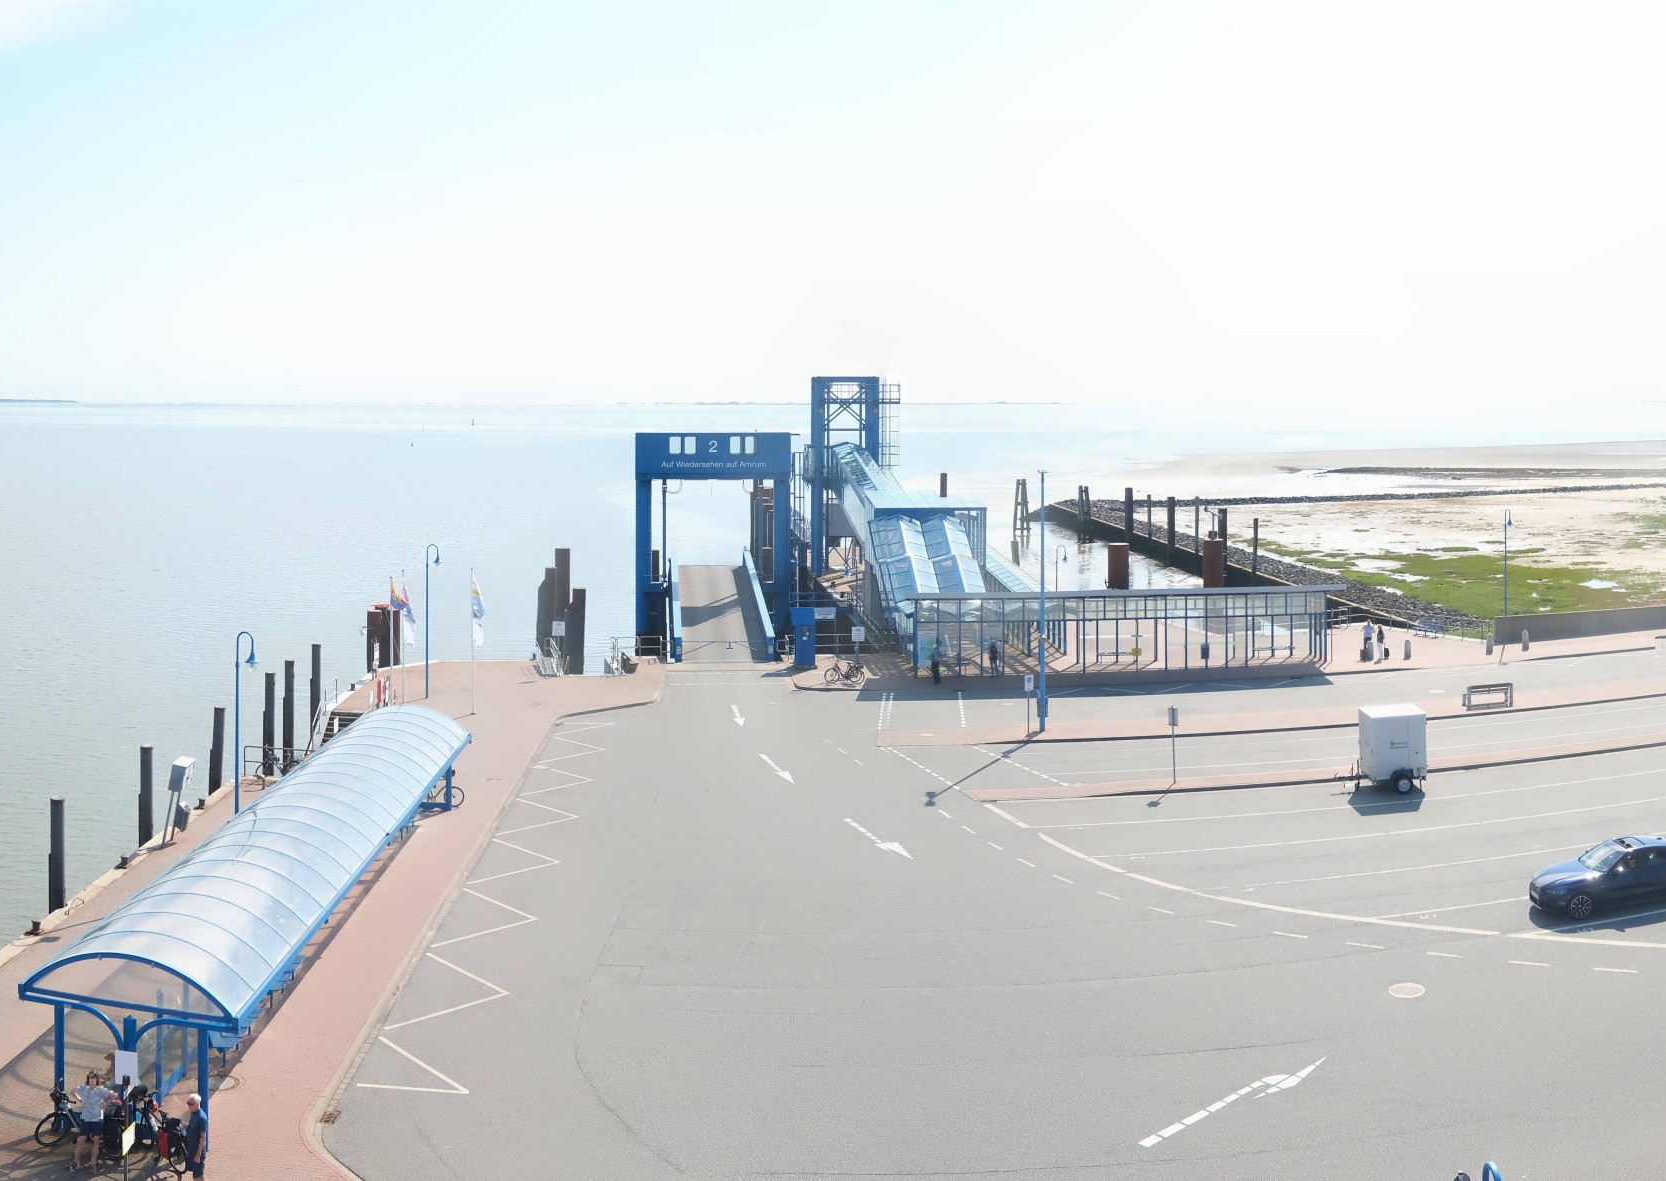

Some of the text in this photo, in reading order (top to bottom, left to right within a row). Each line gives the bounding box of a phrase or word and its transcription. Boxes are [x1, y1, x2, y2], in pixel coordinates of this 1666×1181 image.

[708, 440, 718, 453] 2
[661, 460, 766, 468] Auf Wiedersehen auf Amrum
